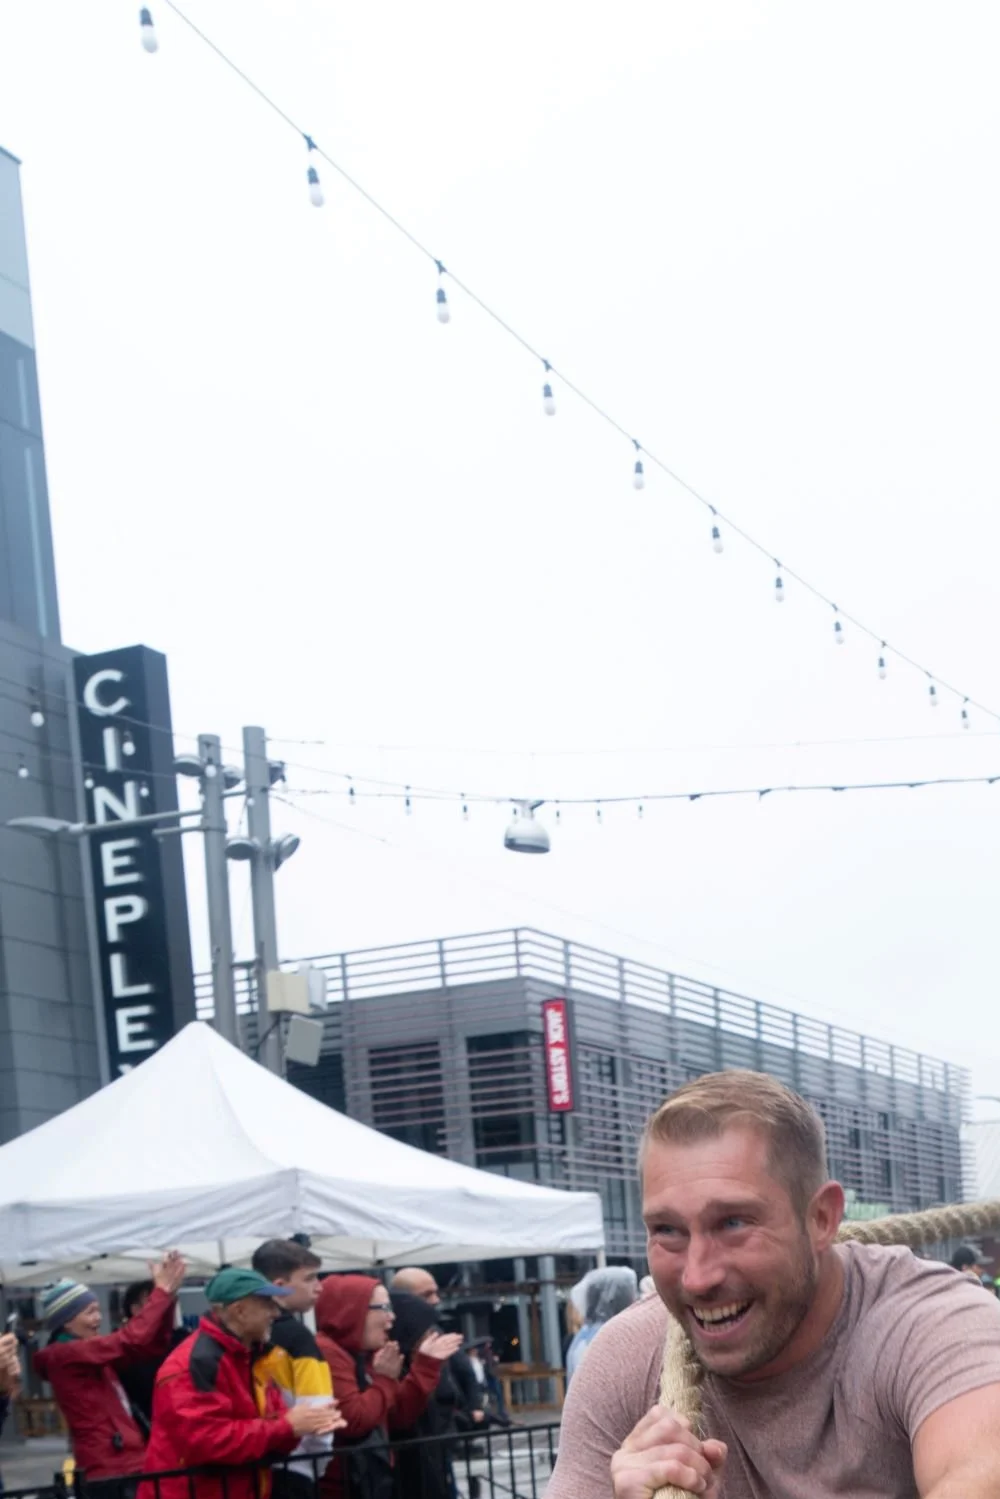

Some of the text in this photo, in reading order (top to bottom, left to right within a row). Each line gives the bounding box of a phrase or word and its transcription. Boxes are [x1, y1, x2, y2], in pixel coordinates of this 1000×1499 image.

[83, 668, 156, 1079] CINEPLE
[546, 1008, 569, 1104] JACK ASTOR'S
